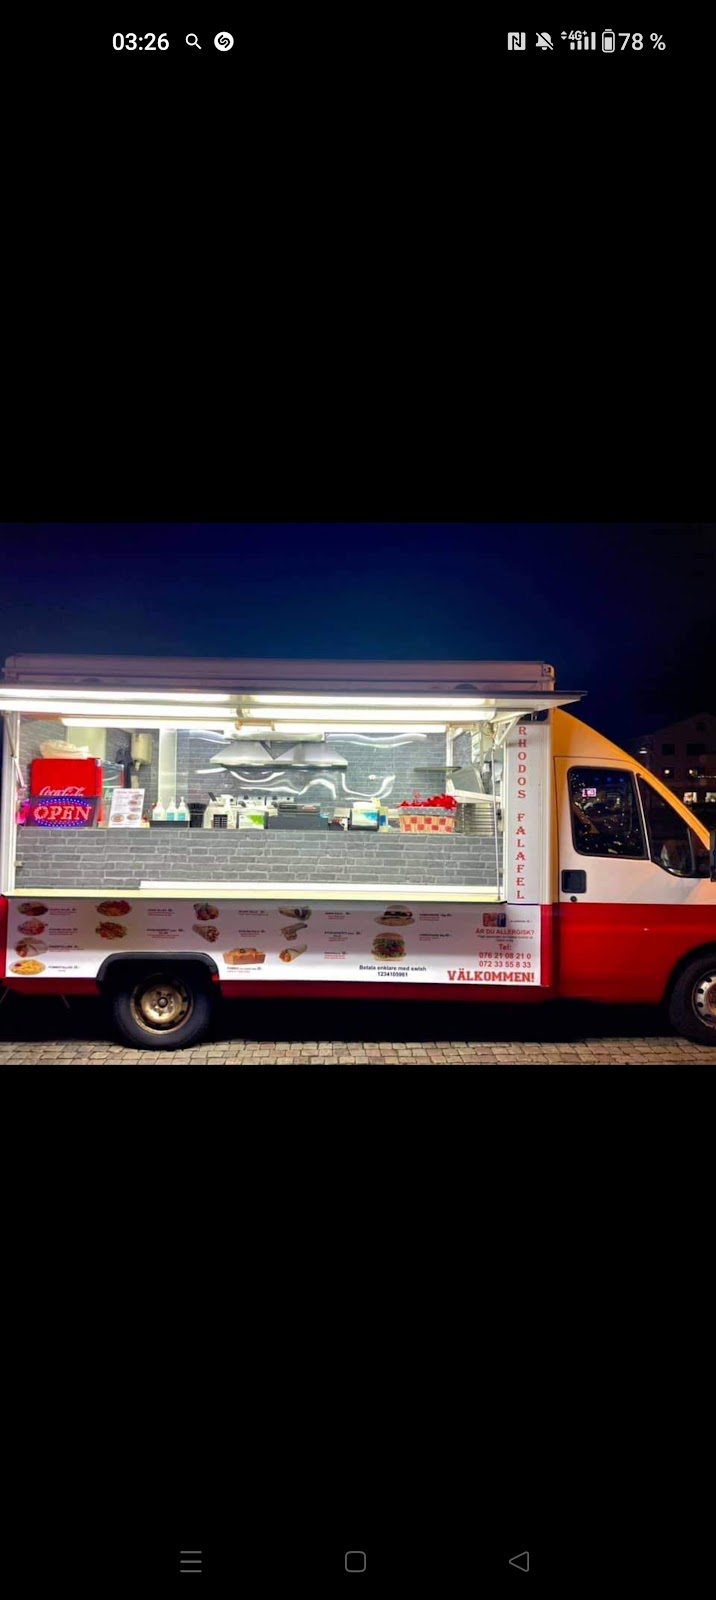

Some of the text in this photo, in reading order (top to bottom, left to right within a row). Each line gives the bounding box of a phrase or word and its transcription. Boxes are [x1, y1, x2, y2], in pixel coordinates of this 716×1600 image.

[33, 805, 92, 820] OPEN
[515, 725, 527, 900] RHODOS FALAFEL
[499, 943, 512, 951] Tel:
[516, 952, 525, 960] 21
[447, 968, 534, 982] VÄLKOMMEN!
